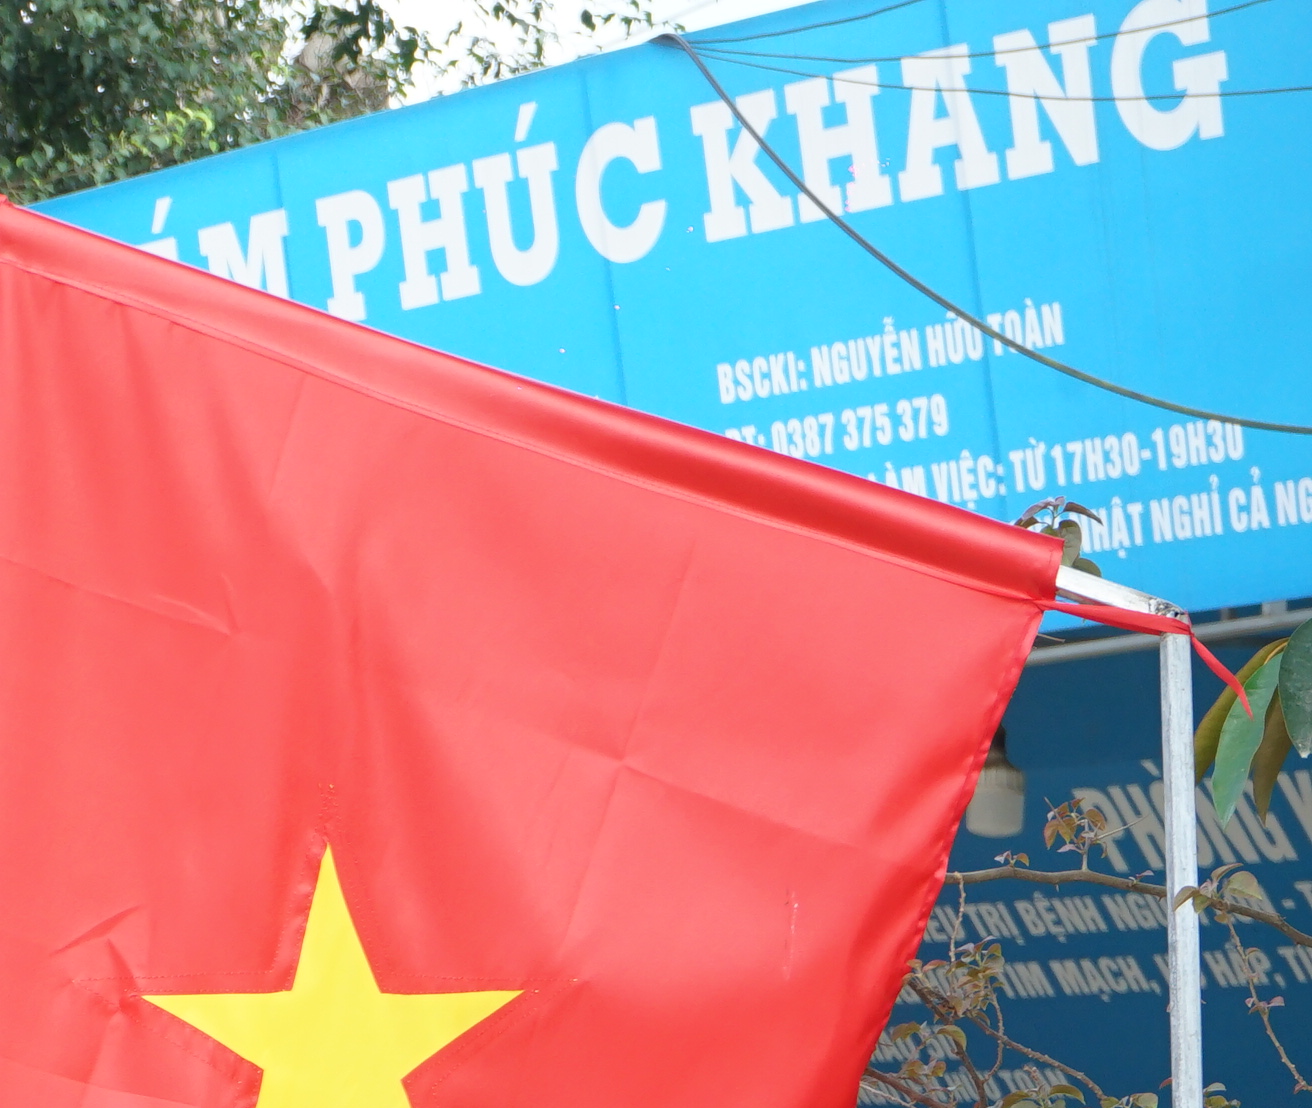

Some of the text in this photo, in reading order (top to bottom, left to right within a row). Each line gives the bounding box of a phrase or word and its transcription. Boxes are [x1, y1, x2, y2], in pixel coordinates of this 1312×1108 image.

[314, 101, 667, 322] PHÚC
[691, 0, 1229, 243] KHANG
[716, 297, 1066, 404] BSCKI: NGUYỄN HỮU TOÀN
[771, 413, 834, 459] 0387
[841, 403, 893, 451] 375
[896, 394, 949, 443] 379
[931, 449, 1006, 509] VIỆC:
[1009, 437, 1046, 494] TỪ
[1050, 419, 1245, 487] 17H30-19H30
[1150, 474, 1224, 544] NGHỈ
[1228, 466, 1272, 533] CẢ
[1013, 890, 1109, 944] BỆNH
[1048, 954, 1162, 1003] MẠCH,
